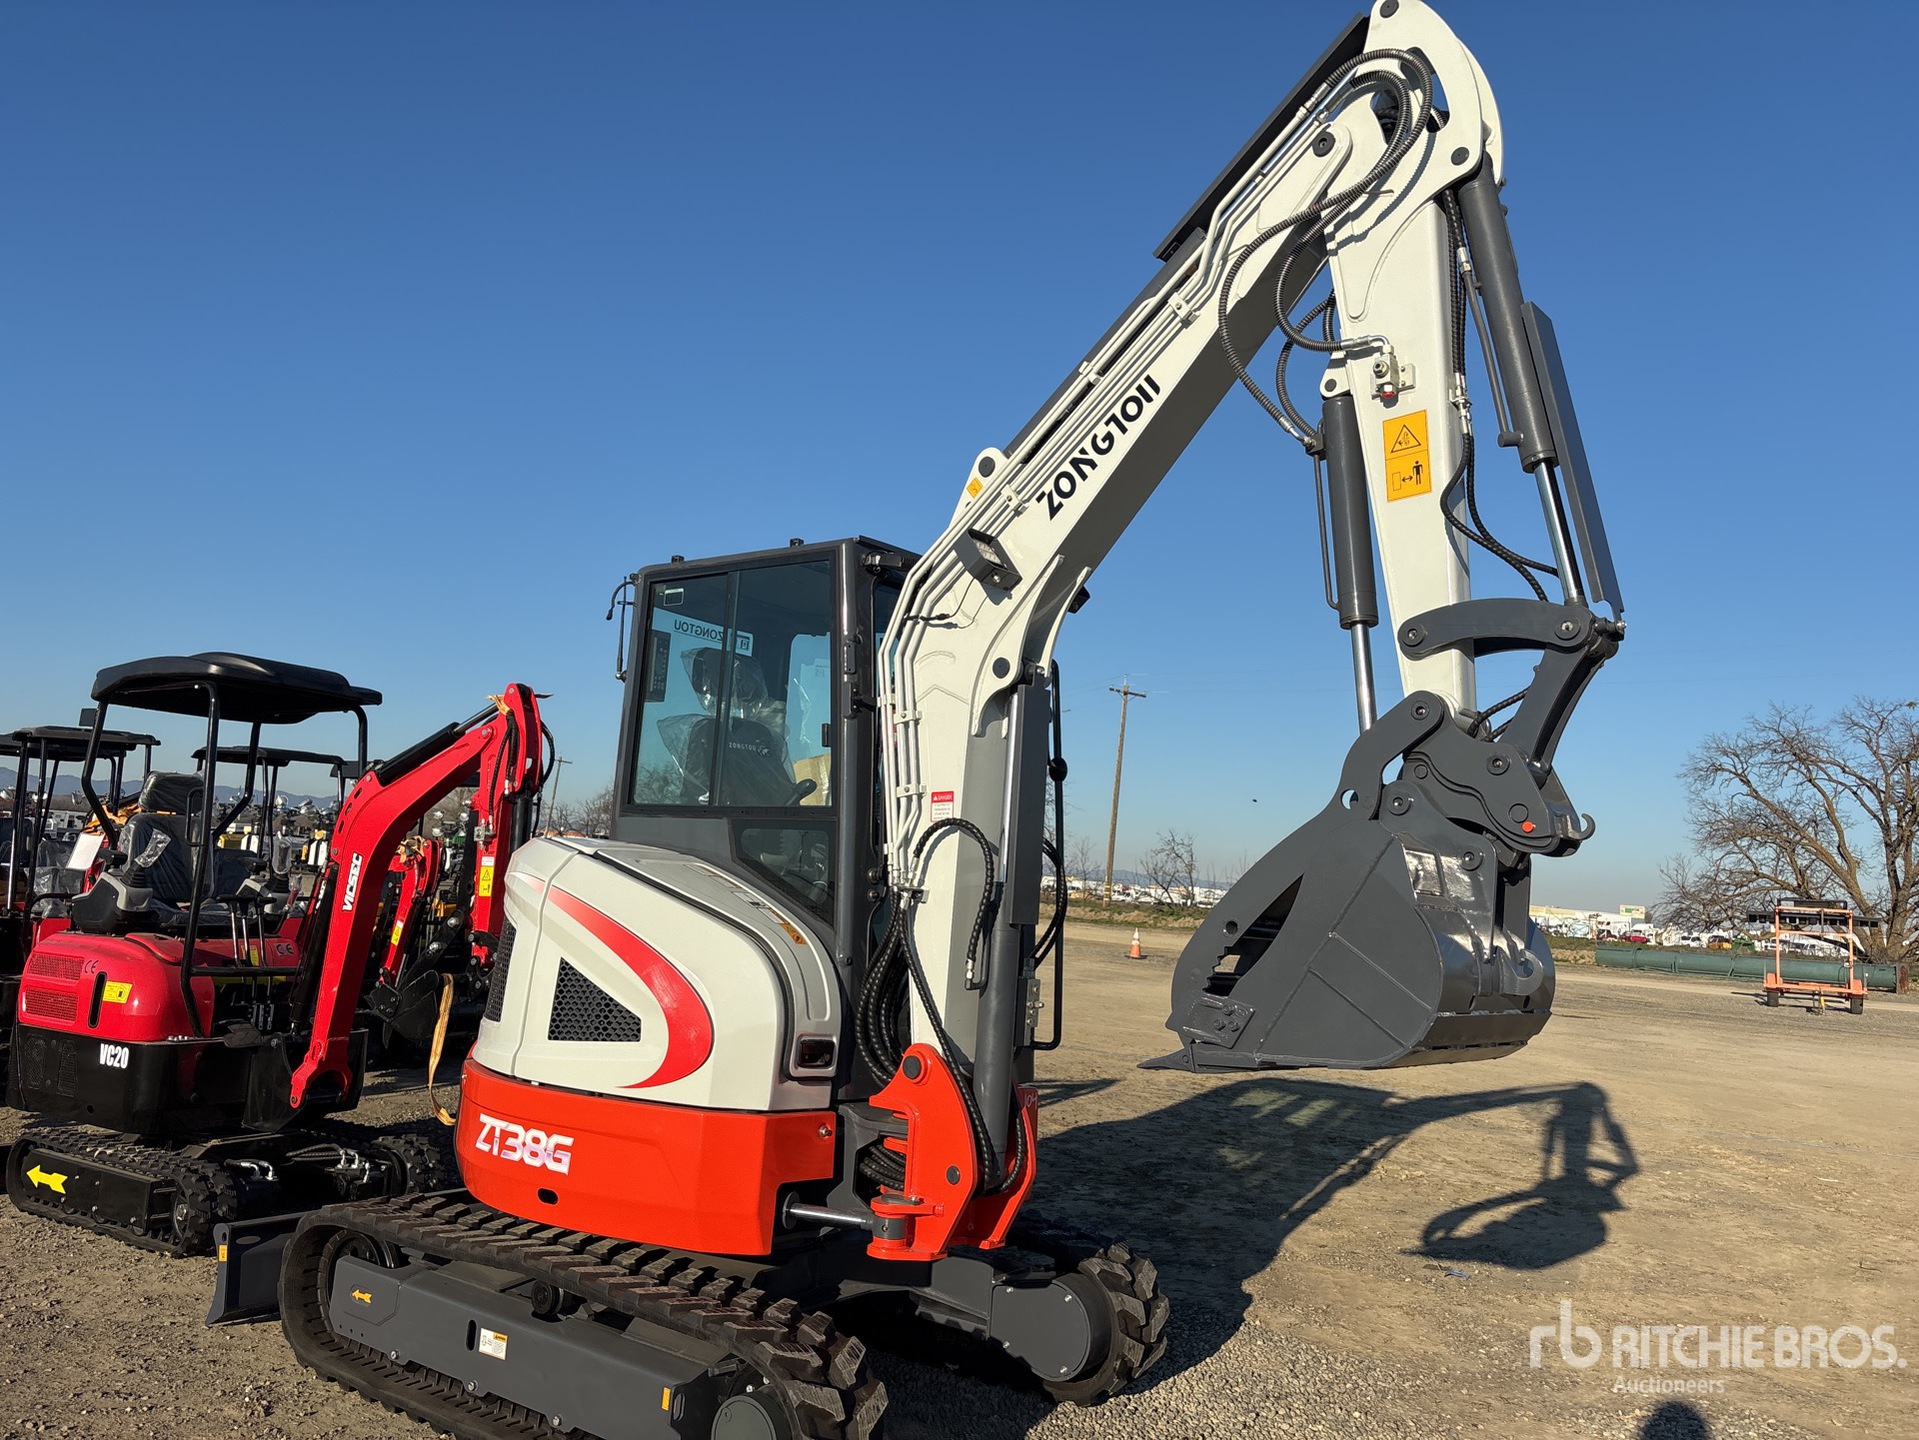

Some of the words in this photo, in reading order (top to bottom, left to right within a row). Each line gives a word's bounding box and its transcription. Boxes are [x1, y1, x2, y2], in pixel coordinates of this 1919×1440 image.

[1035, 374, 1161, 521] ZONGTOU
[342, 852, 363, 911] VICSEC
[85, 960, 99, 974] CE
[99, 1043, 129, 1069] VC20
[475, 1113, 575, 1176] ZT38G
